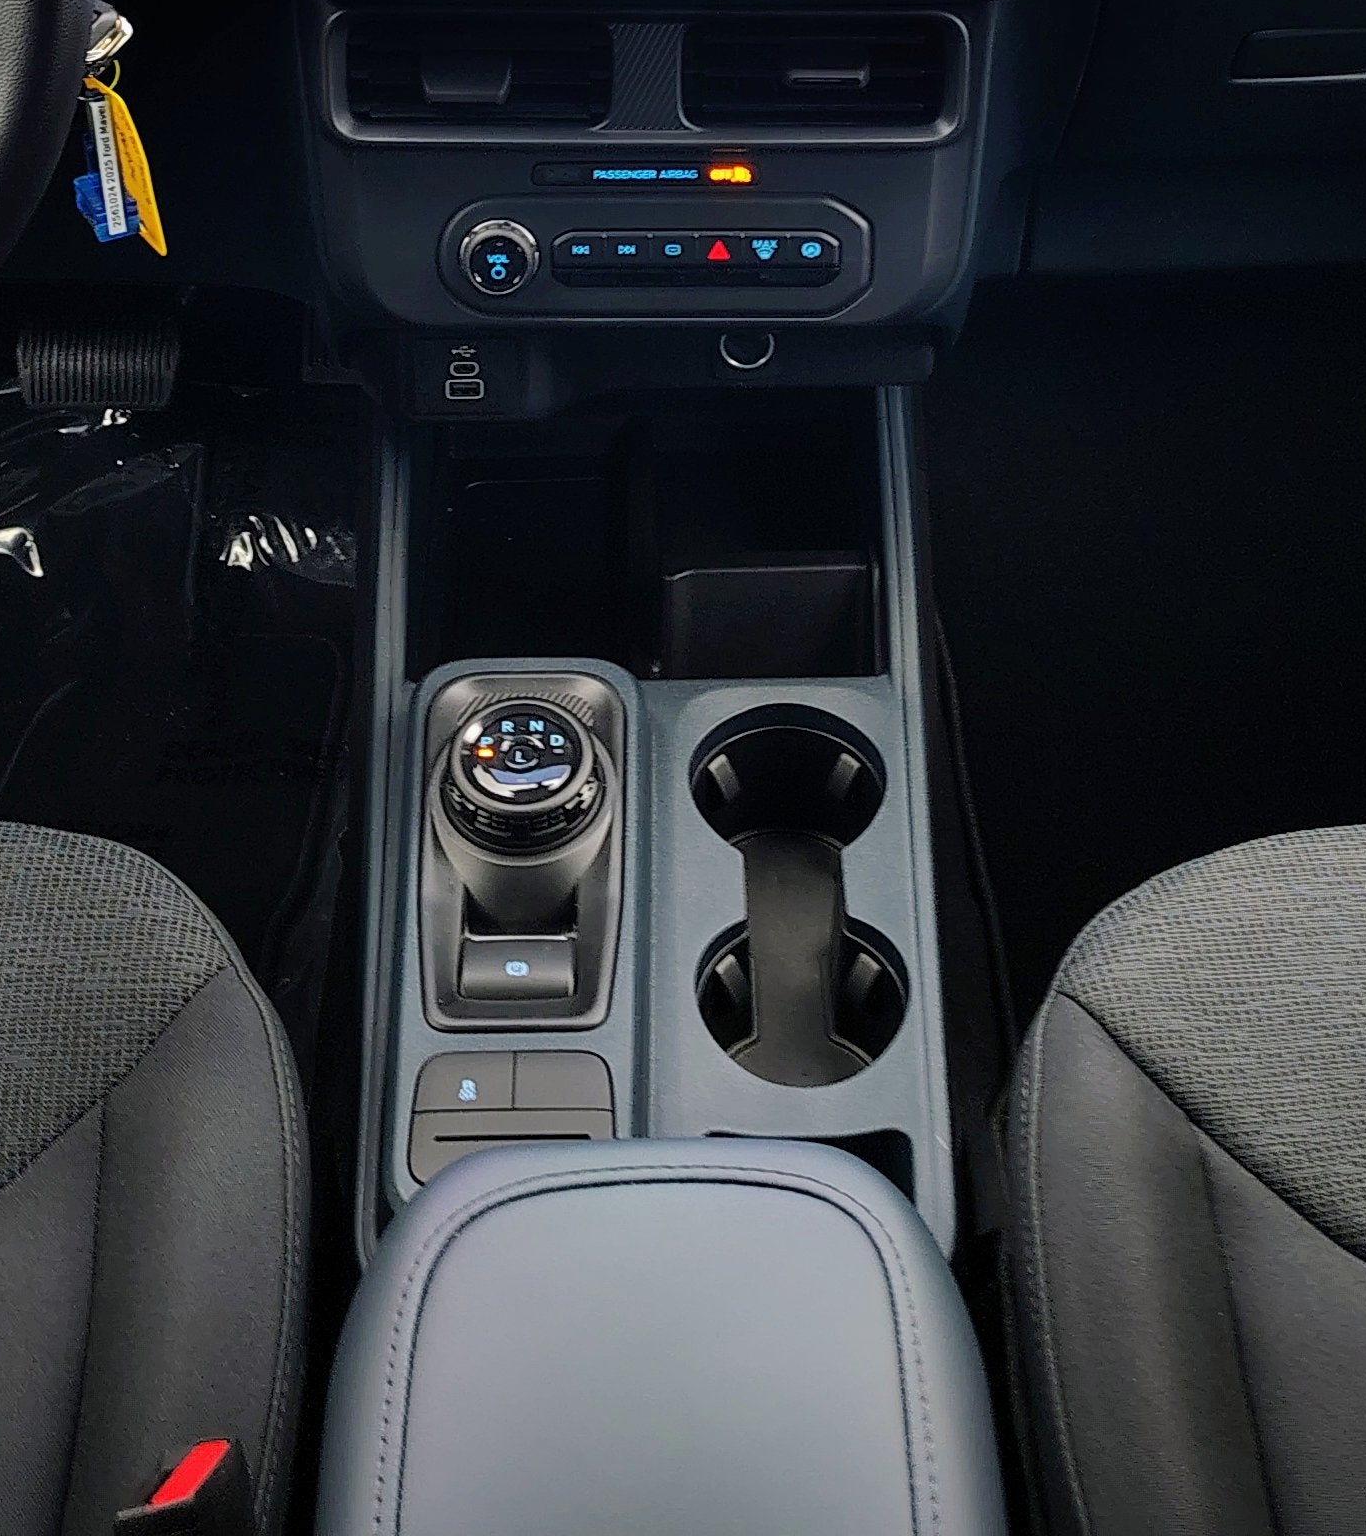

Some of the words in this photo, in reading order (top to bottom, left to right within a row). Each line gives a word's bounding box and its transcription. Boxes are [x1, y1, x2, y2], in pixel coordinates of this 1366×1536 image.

[100, 136, 112, 157] Ford
[104, 159, 116, 184] 2025
[592, 168, 658, 180] PASSENGER
[658, 168, 699, 180] AIRBAG
[751, 239, 779, 249] MAX
[486, 253, 510, 264] VOL
[480, 736, 494, 748] P
[501, 720, 515, 733] R
[528, 720, 545, 732] N
[549, 734, 565, 746] D
[515, 750, 527, 763] L
